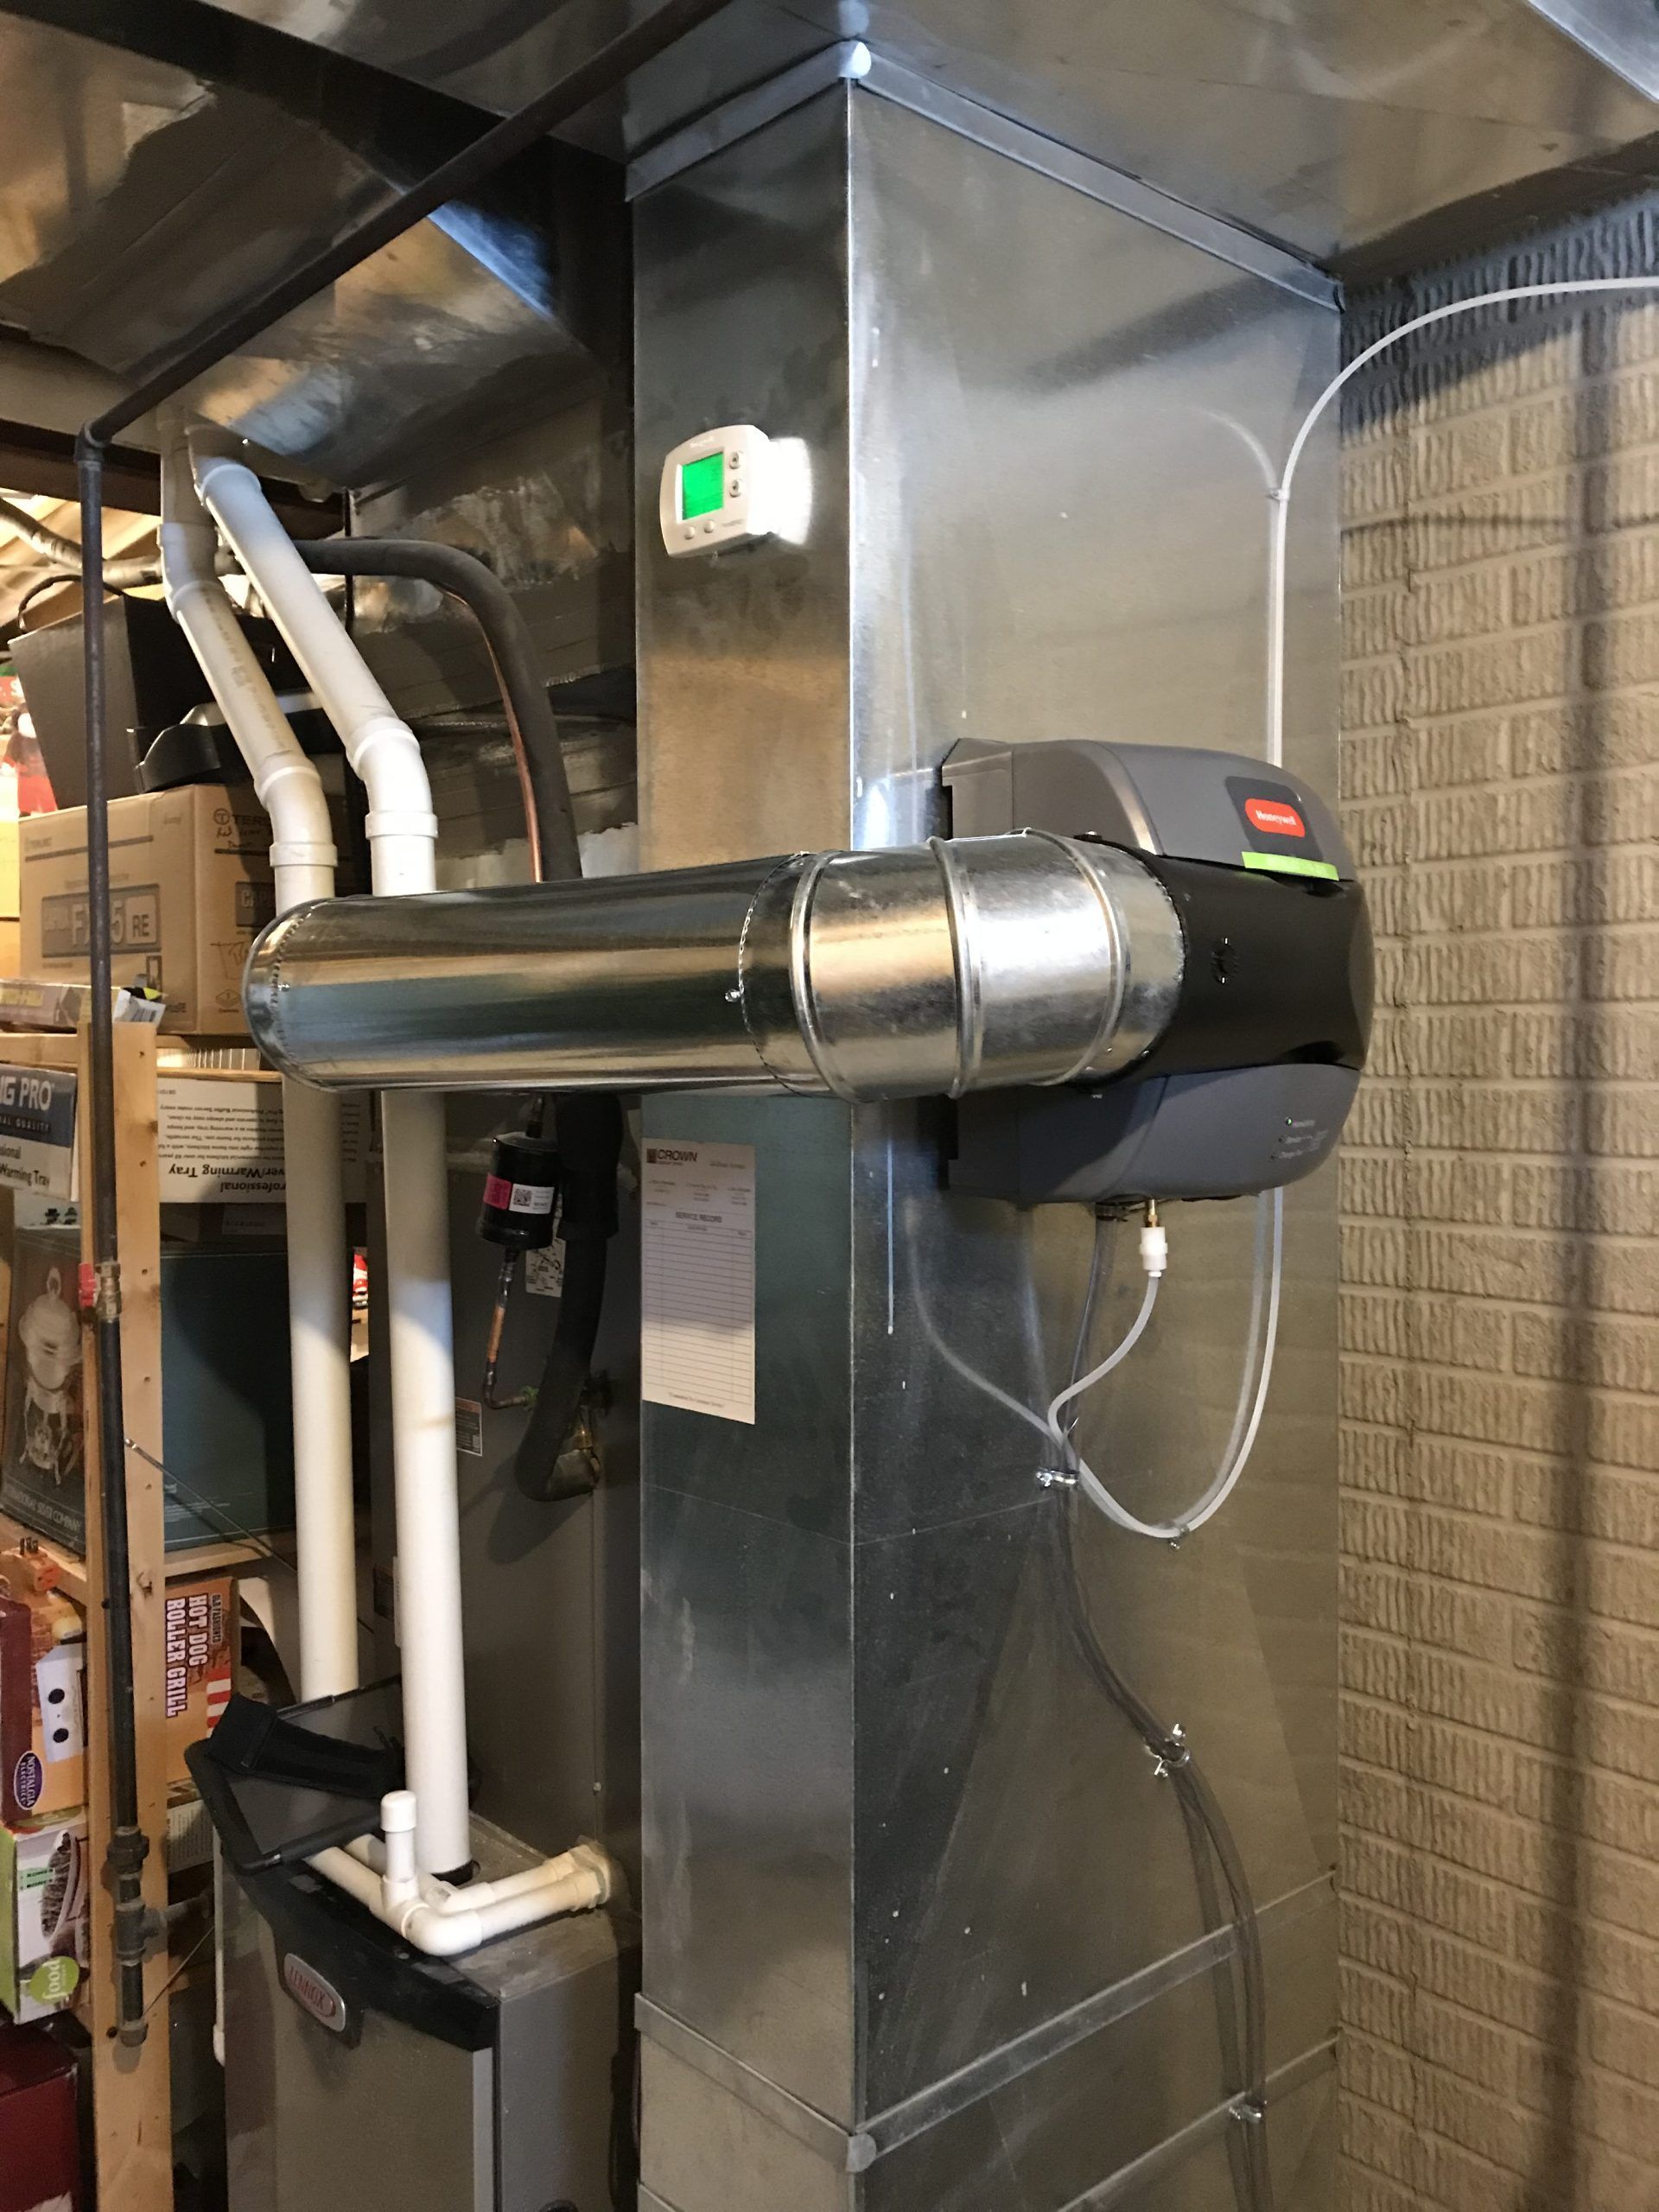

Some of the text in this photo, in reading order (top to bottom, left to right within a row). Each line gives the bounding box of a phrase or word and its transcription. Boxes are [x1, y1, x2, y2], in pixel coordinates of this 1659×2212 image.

[1255, 810, 1297, 826] Honeywell
[131, 914, 149, 938] RE
[18, 1077, 52, 1111] PRO
[168, 1164, 198, 1178] Tray
[657, 1149, 698, 1162] CROWN
[676, 1211, 722, 1223] SERVICE RECORD
[188, 1594, 208, 1666] HOT DOG
[211, 1608, 222, 1643] FASHIONED
[167, 1598, 187, 1717] ROLLER GRILL
[26, 1755, 36, 1807] NOSTALGIA
[41, 1959, 69, 1999] food
[289, 1966, 325, 2010] LENNOX
